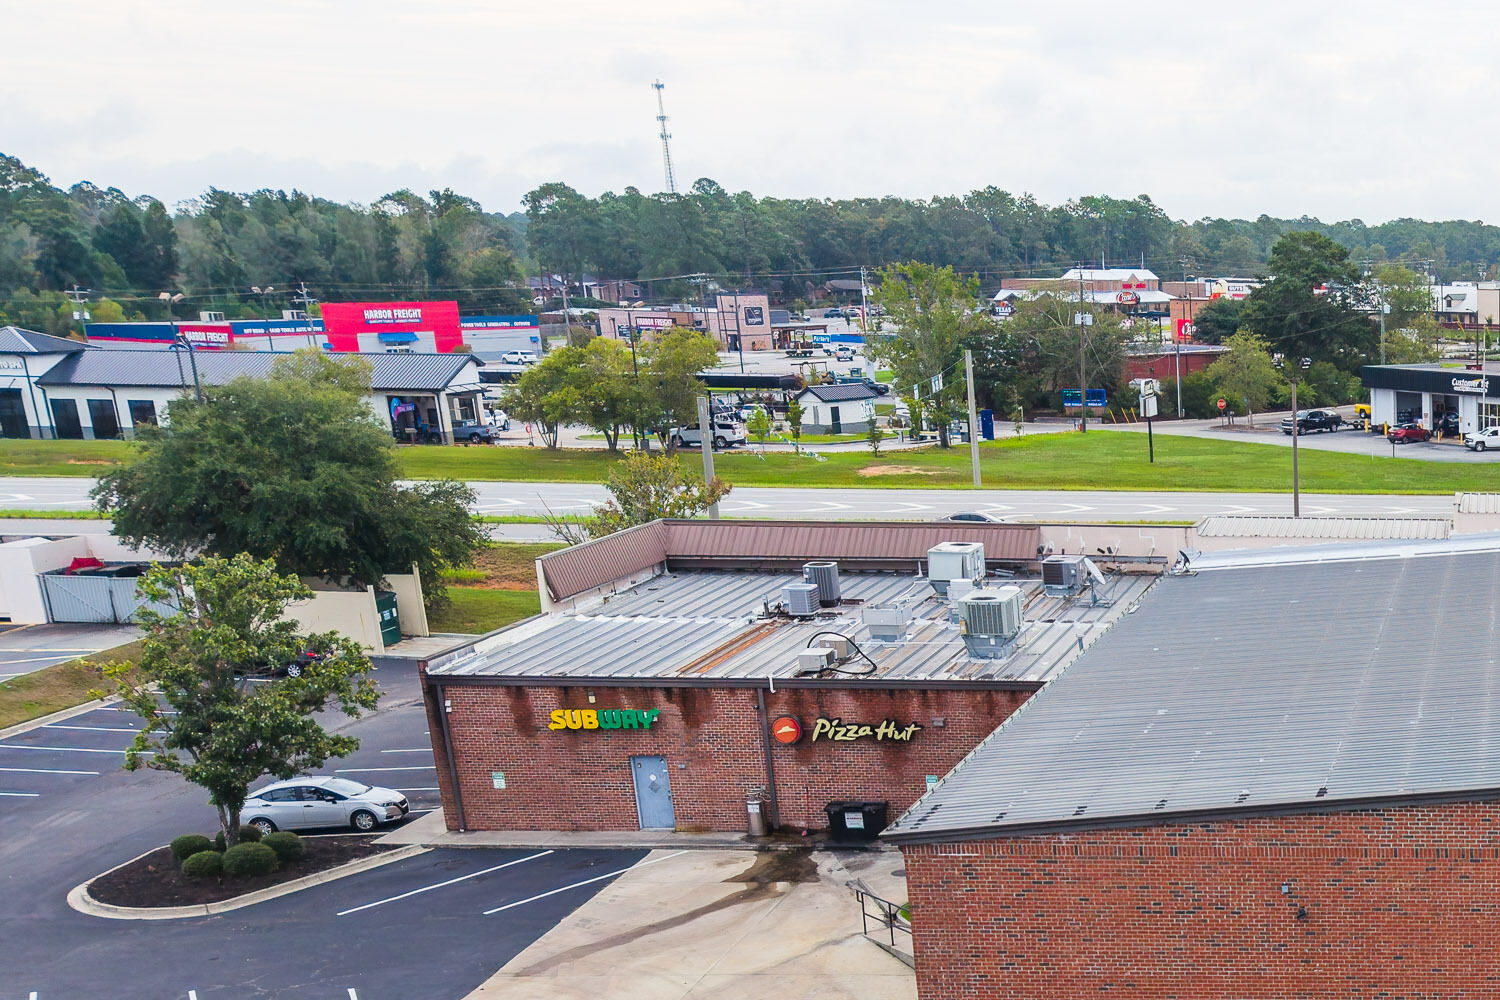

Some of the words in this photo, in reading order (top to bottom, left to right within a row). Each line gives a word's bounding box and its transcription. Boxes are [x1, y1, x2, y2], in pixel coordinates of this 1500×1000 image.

[364, 309, 392, 319] HARBOR
[393, 309, 421, 318] FREIGHT
[547, 707, 661, 731] SUBWAY
[812, 717, 874, 742] Pizza
[875, 720, 922, 741] Hut
